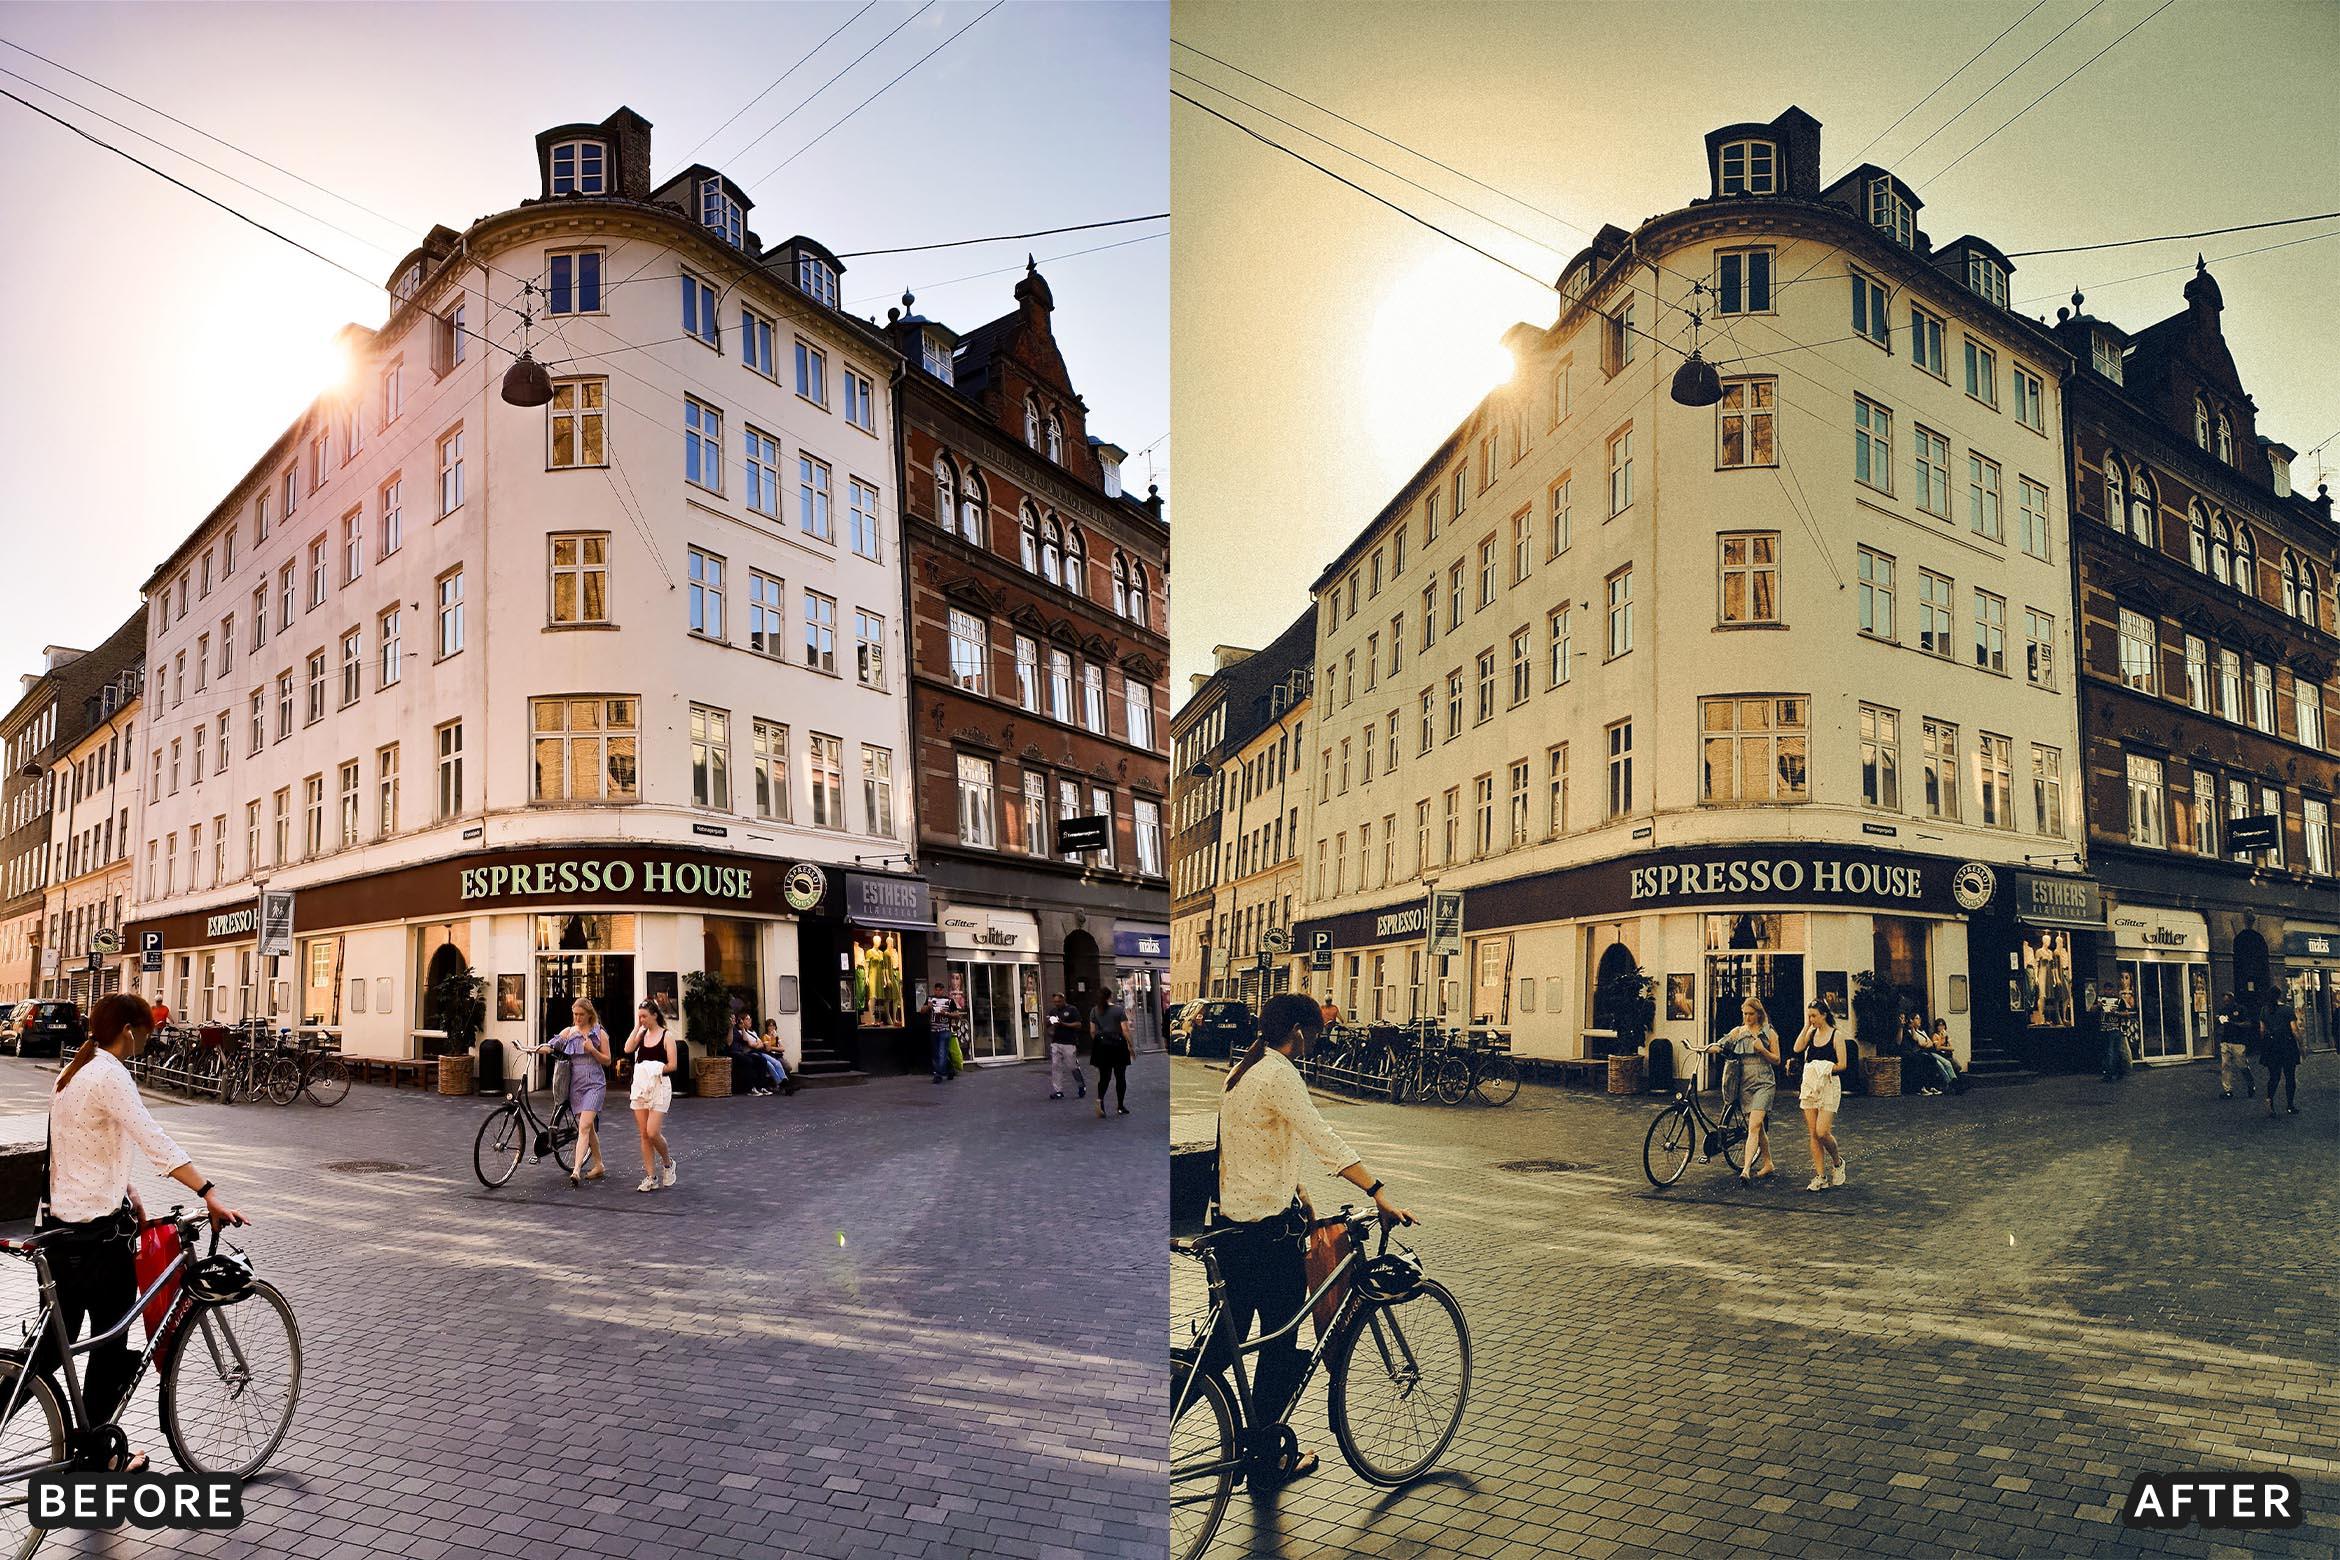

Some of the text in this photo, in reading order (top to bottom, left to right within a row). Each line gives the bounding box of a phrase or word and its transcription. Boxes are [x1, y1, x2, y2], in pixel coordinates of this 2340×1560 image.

[460, 861, 753, 899] ESPRESSO HOUSE
[786, 864, 820, 883] ESPRESSO
[1630, 860, 1922, 899] ESPRESSO HOUSE
[1956, 864, 1989, 883] ESPRESSO
[790, 894, 818, 907] HOUSE
[862, 880, 917, 908] ESTHERS
[1960, 893, 1986, 906] HOUSE
[2032, 879, 2087, 908] ESTHERS
[207, 909, 252, 937] ESPRESSO
[945, 919, 978, 928] Glitter
[1376, 909, 1422, 937] ESPRESSO
[2114, 918, 2147, 928] Glitter
[146, 934, 159, 950] P
[1138, 937, 1160, 954] matas
[1316, 933, 1328, 949] P
[2308, 936, 2330, 953] matas
